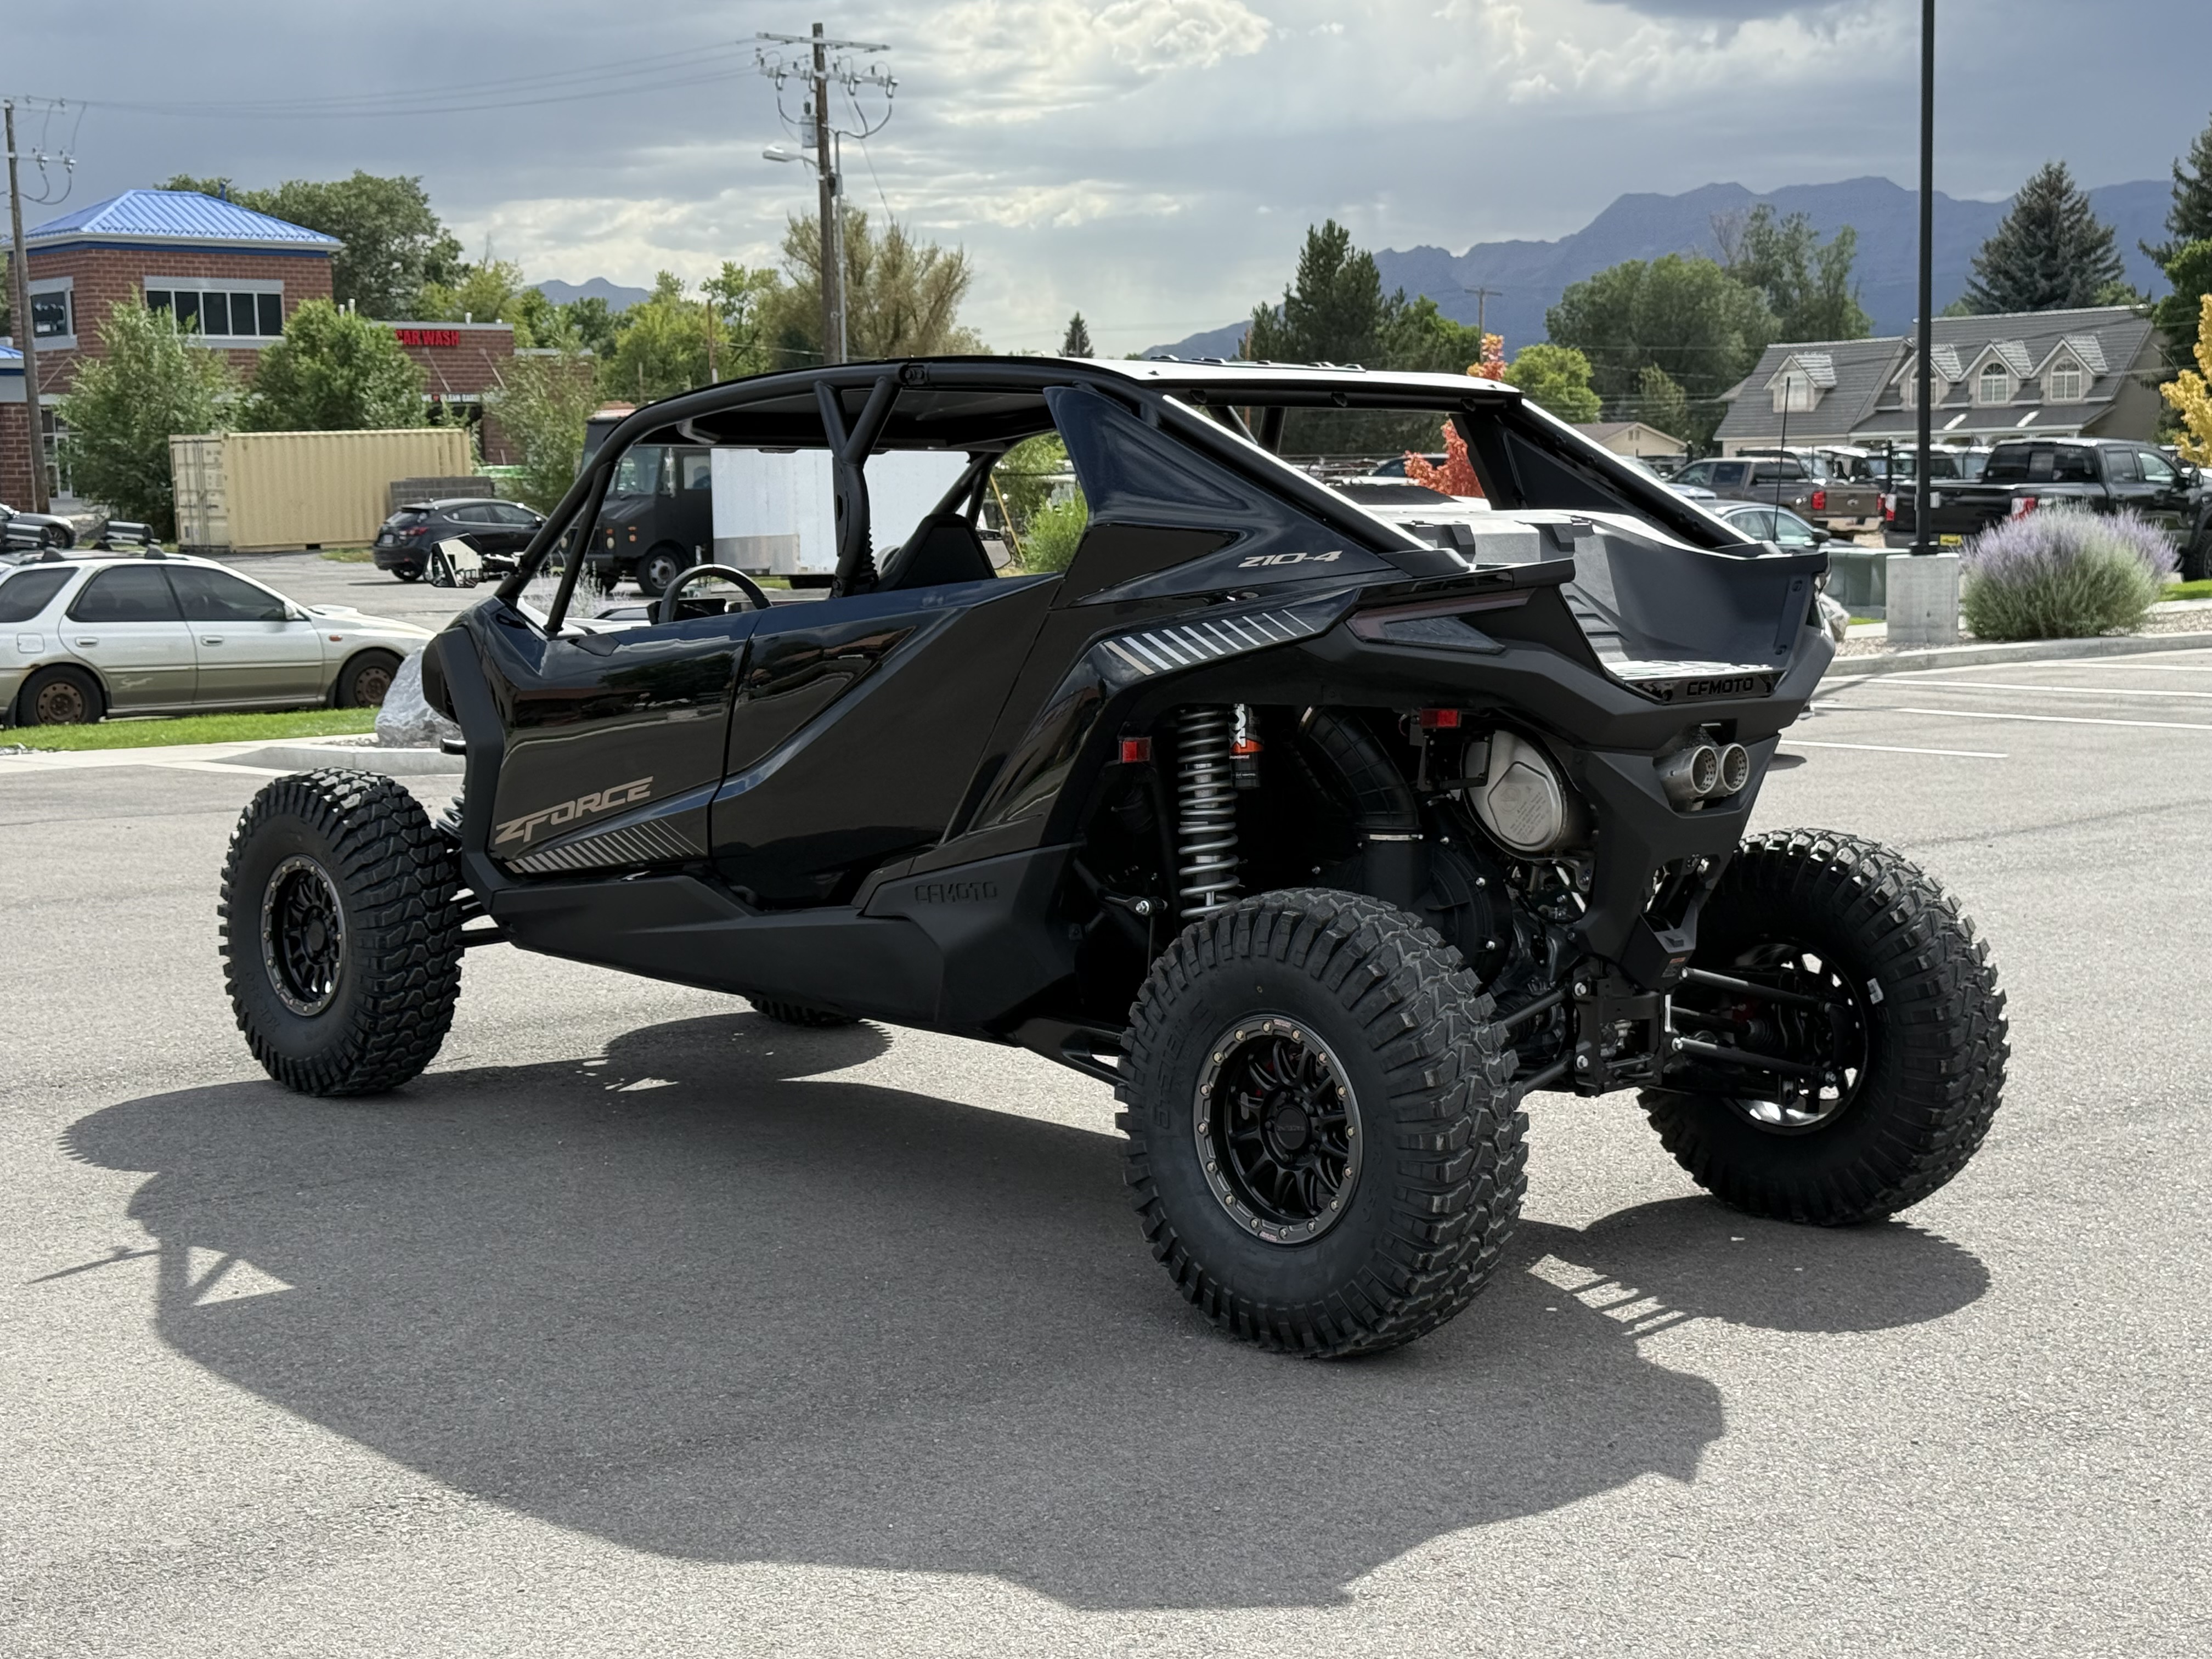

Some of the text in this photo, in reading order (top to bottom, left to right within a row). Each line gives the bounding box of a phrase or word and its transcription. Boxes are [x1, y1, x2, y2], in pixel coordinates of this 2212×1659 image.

[395, 329, 459, 346] CAR WASH
[1238, 550, 1343, 568] Z10-4
[1686, 677, 1754, 696] CFMOTO
[495, 776, 654, 844] ZFORCE
[915, 882, 997, 904] CFMOTO
